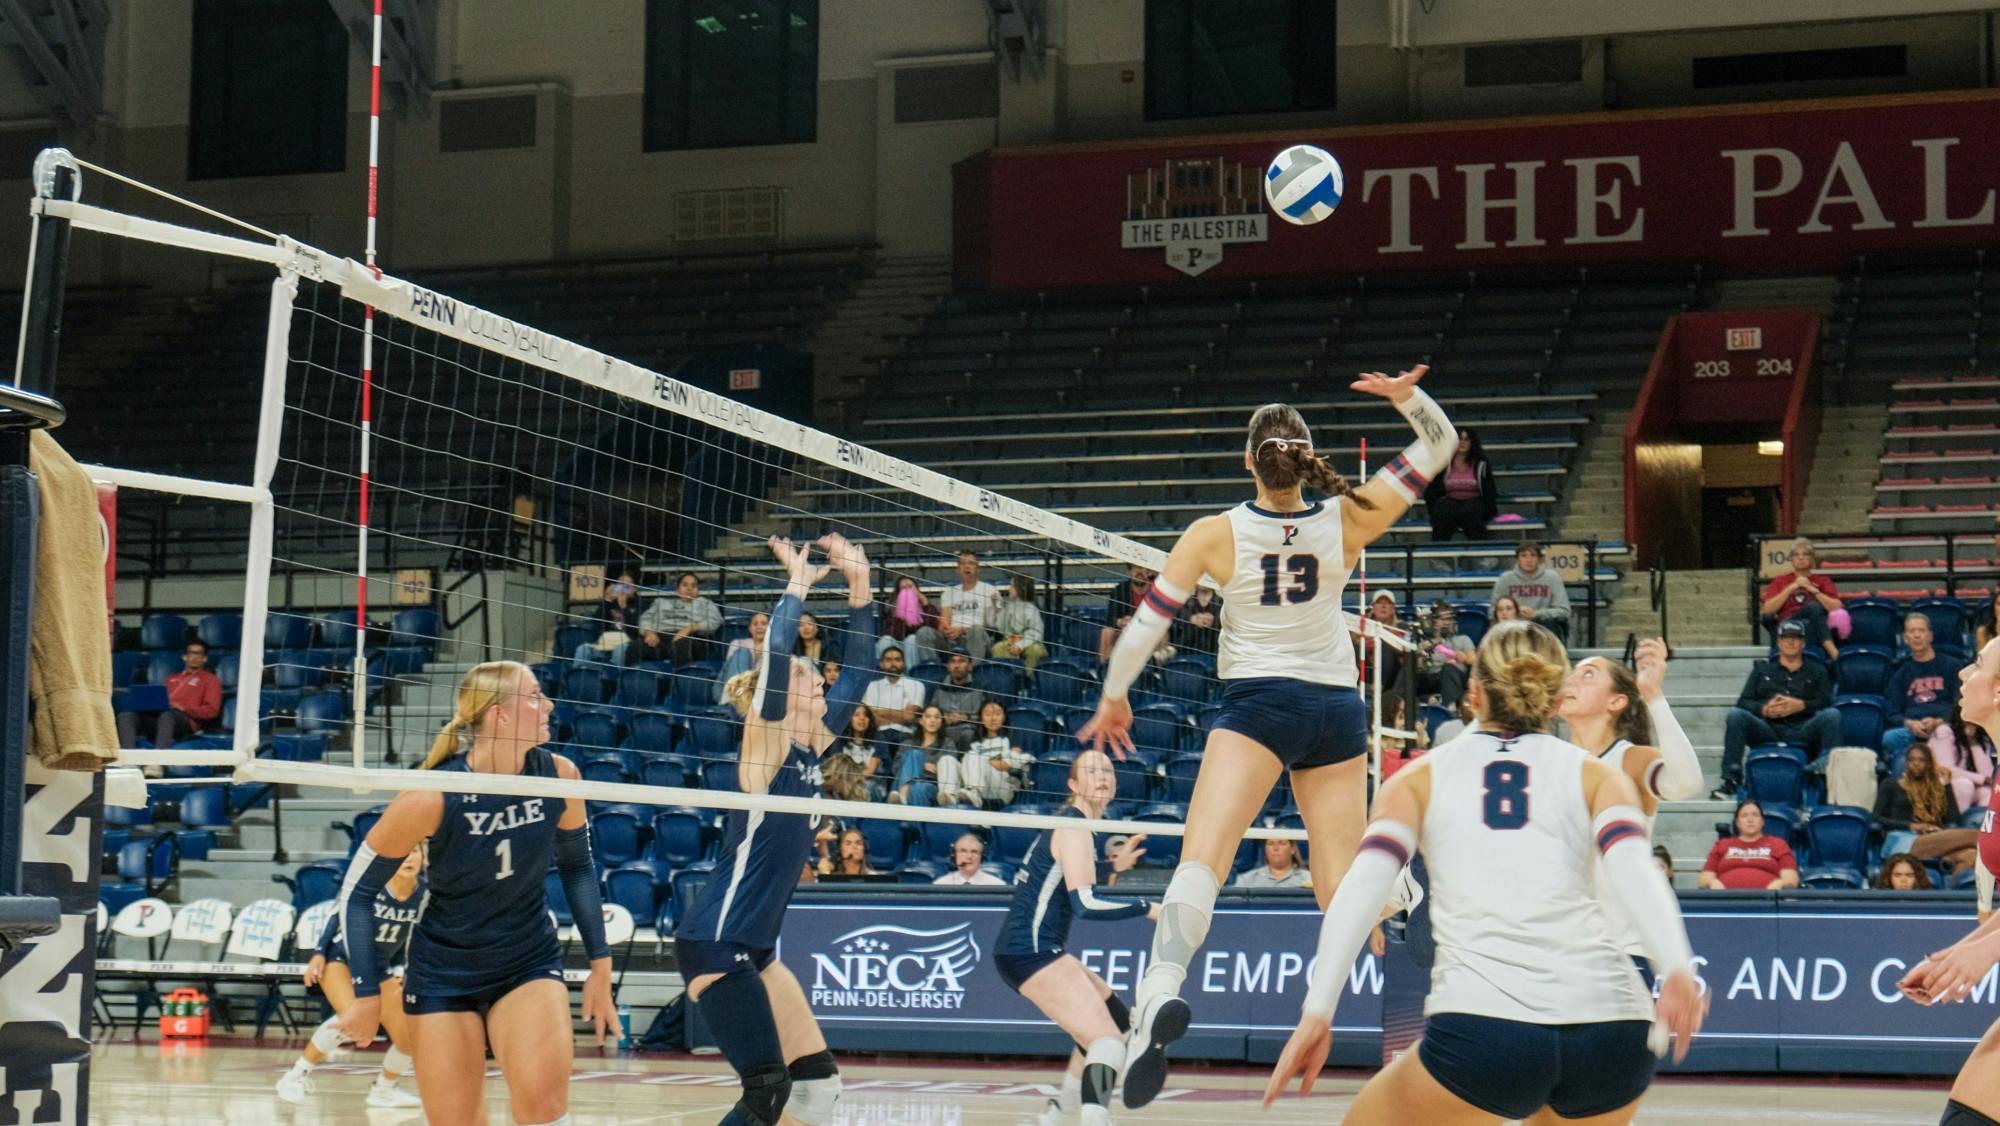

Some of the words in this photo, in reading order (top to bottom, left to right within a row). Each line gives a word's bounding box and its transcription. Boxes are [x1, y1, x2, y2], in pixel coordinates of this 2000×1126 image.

[1362, 155, 1645, 253] THE
[1721, 137, 1997, 238] PAL
[1132, 224, 1163, 243] THE
[1172, 219, 1258, 241] PALESTRA
[1187, 248, 1203, 267] P
[411, 286, 456, 326] PENN
[458, 304, 558, 362] VOLLEYBALL
[1695, 361, 1730, 378] 203
[1757, 358, 1793, 376] 204
[653, 375, 688, 408] PENN
[837, 440, 863, 466] PENN
[1282, 525, 1298, 546] P
[1551, 555, 1579, 569] 103
[575, 576, 599, 588] 103
[1260, 553, 1320, 606] 13
[1509, 584, 1549, 598] PENN
[1483, 760, 1530, 830] 8
[464, 799, 545, 836] YALE
[495, 839, 515, 880] 1
[373, 904, 419, 923] YALE
[375, 923, 402, 943] 11
[811, 953, 965, 992] NECA
[1202, 951, 1386, 995] EMPW
[1727, 956, 1848, 1001] AND
[811, 990, 965, 1009] PENN-DEL-JERSEY
